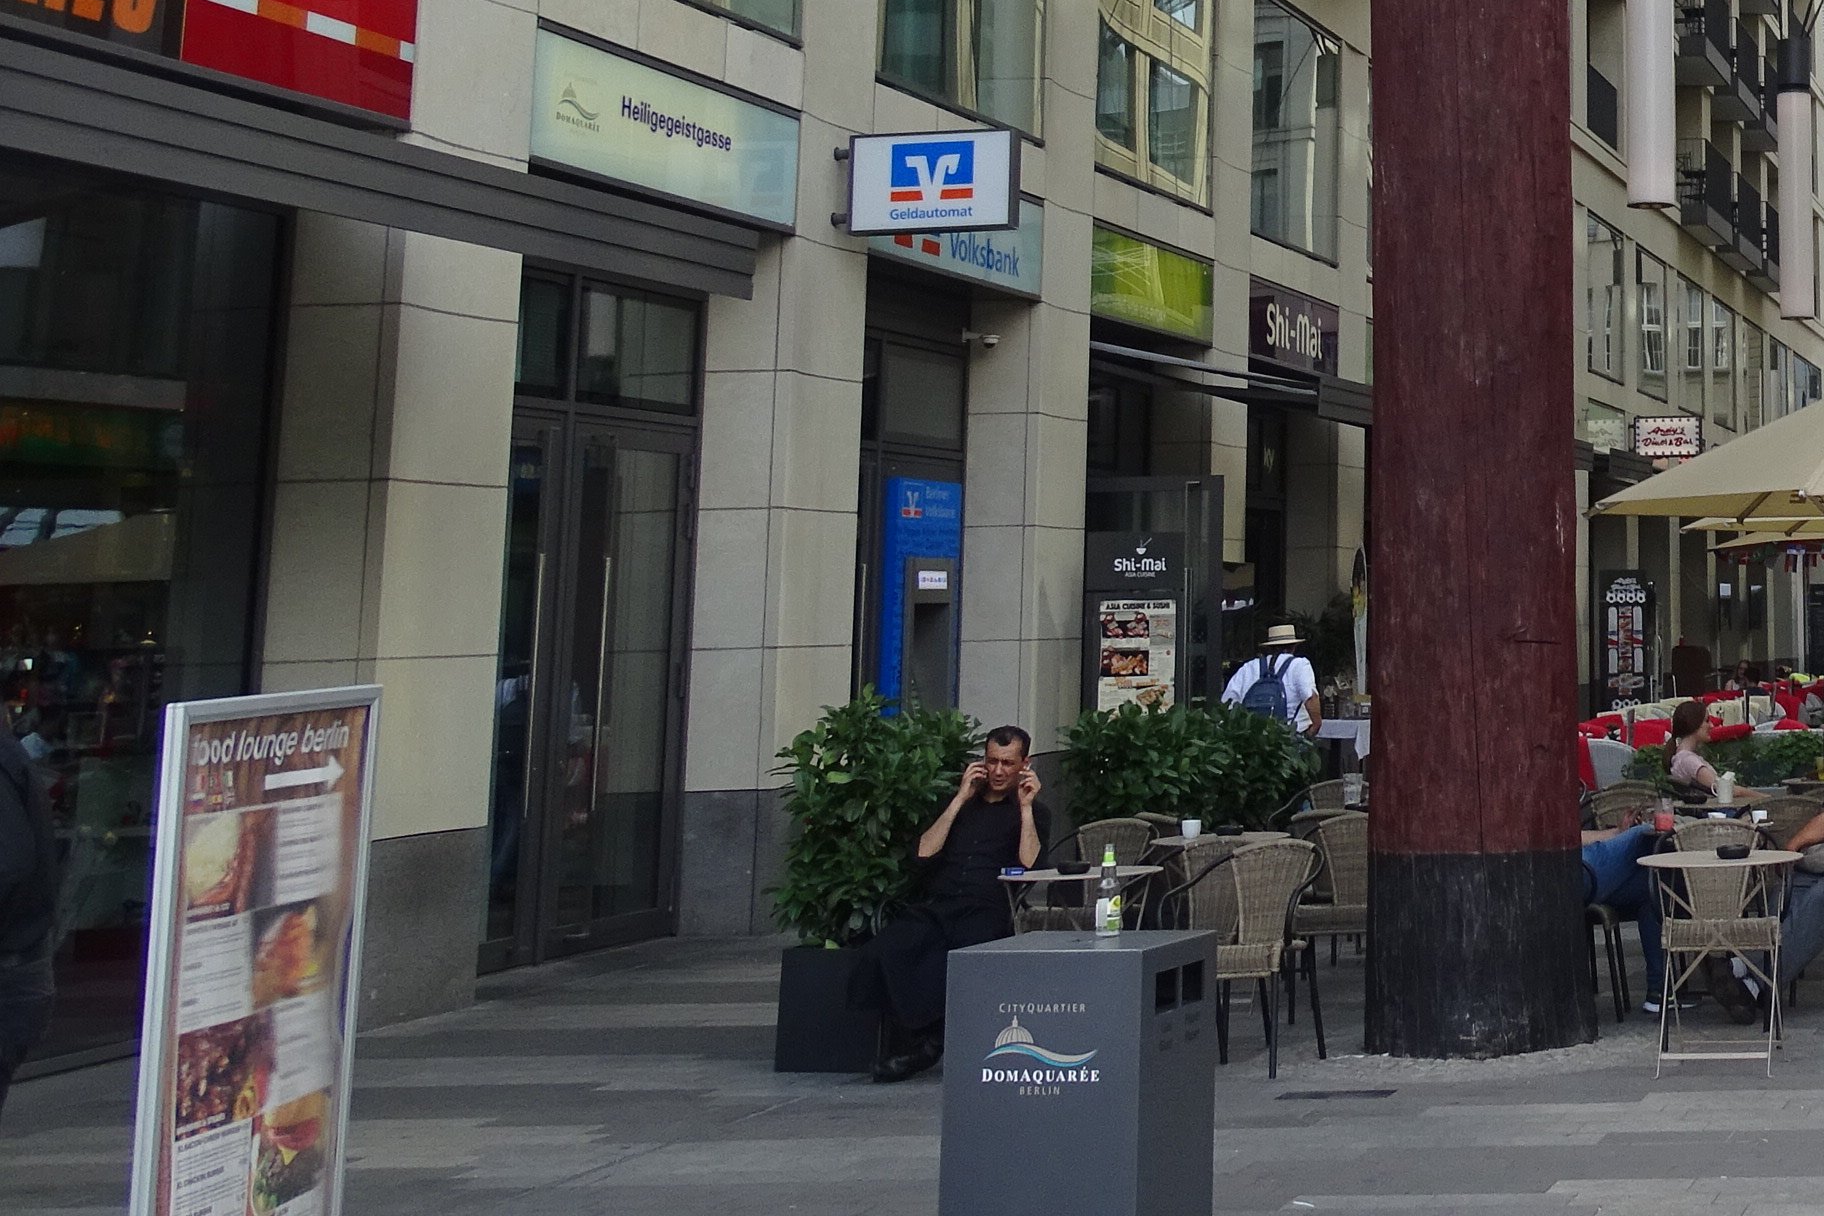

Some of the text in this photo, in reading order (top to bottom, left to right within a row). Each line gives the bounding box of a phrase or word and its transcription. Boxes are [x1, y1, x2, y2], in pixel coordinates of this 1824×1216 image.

[621, 95, 732, 152] Heiligegeistgasse
[890, 206, 973, 220] Geldautomat
[950, 233, 1020, 278] Volksbank
[1266, 302, 1323, 361] Shi-Mai
[1647, 426, 1686, 437] Andy's
[1641, 437, 1668, 447] Diner
[1674, 437, 1694, 447] Bar
[1114, 557, 1167, 572] Shi-Mai
[236, 730, 298, 766] lounge
[301, 720, 349, 753] berlin
[999, 1002, 1086, 1014] CITYQUARTIER
[1019, 1086, 1061, 1096] BERLIN
